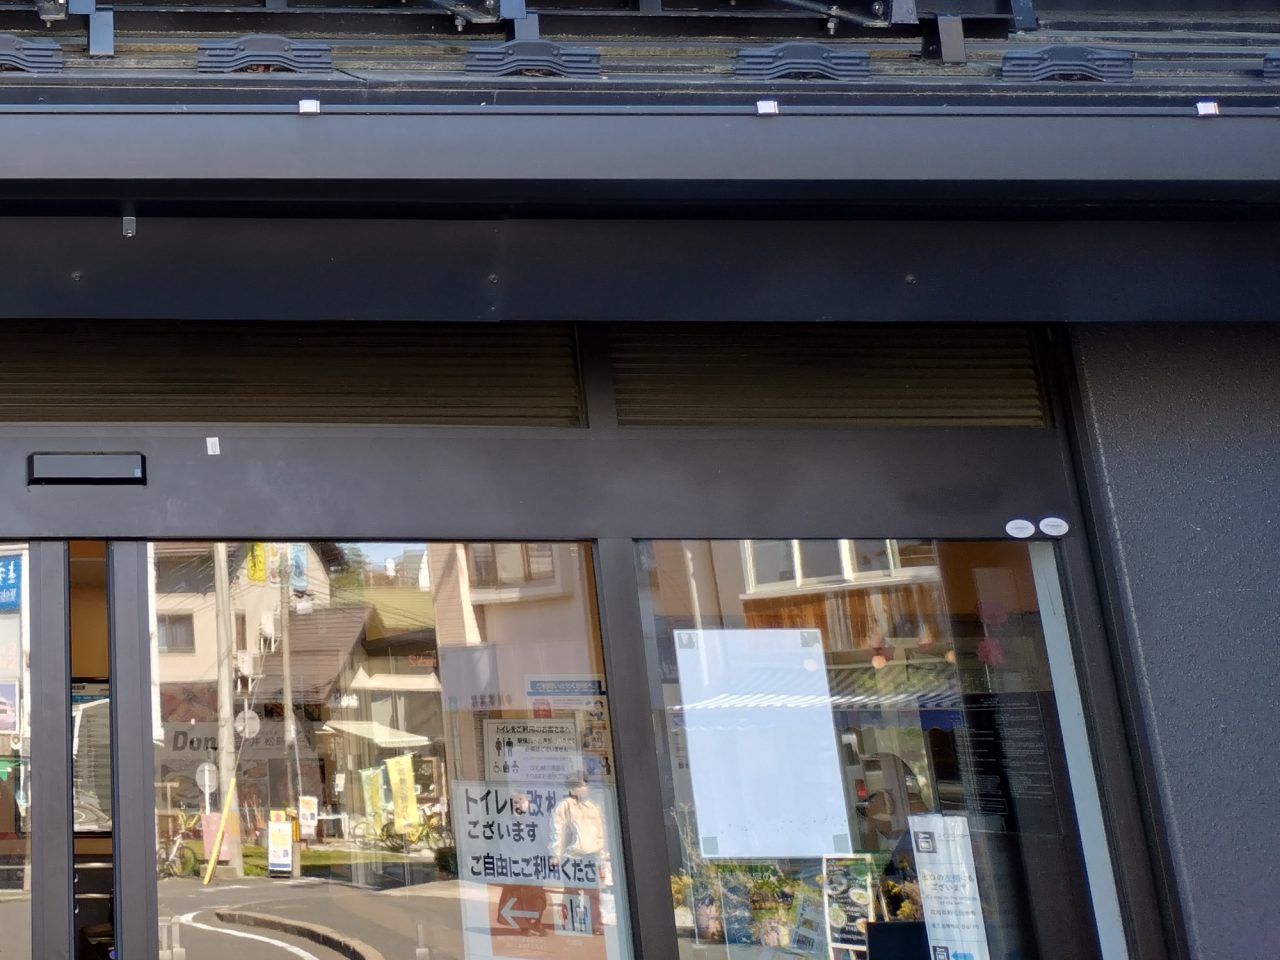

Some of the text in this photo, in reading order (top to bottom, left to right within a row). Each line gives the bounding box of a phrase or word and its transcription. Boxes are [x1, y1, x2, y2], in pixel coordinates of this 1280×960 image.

[468, 820, 538, 843] ございます
